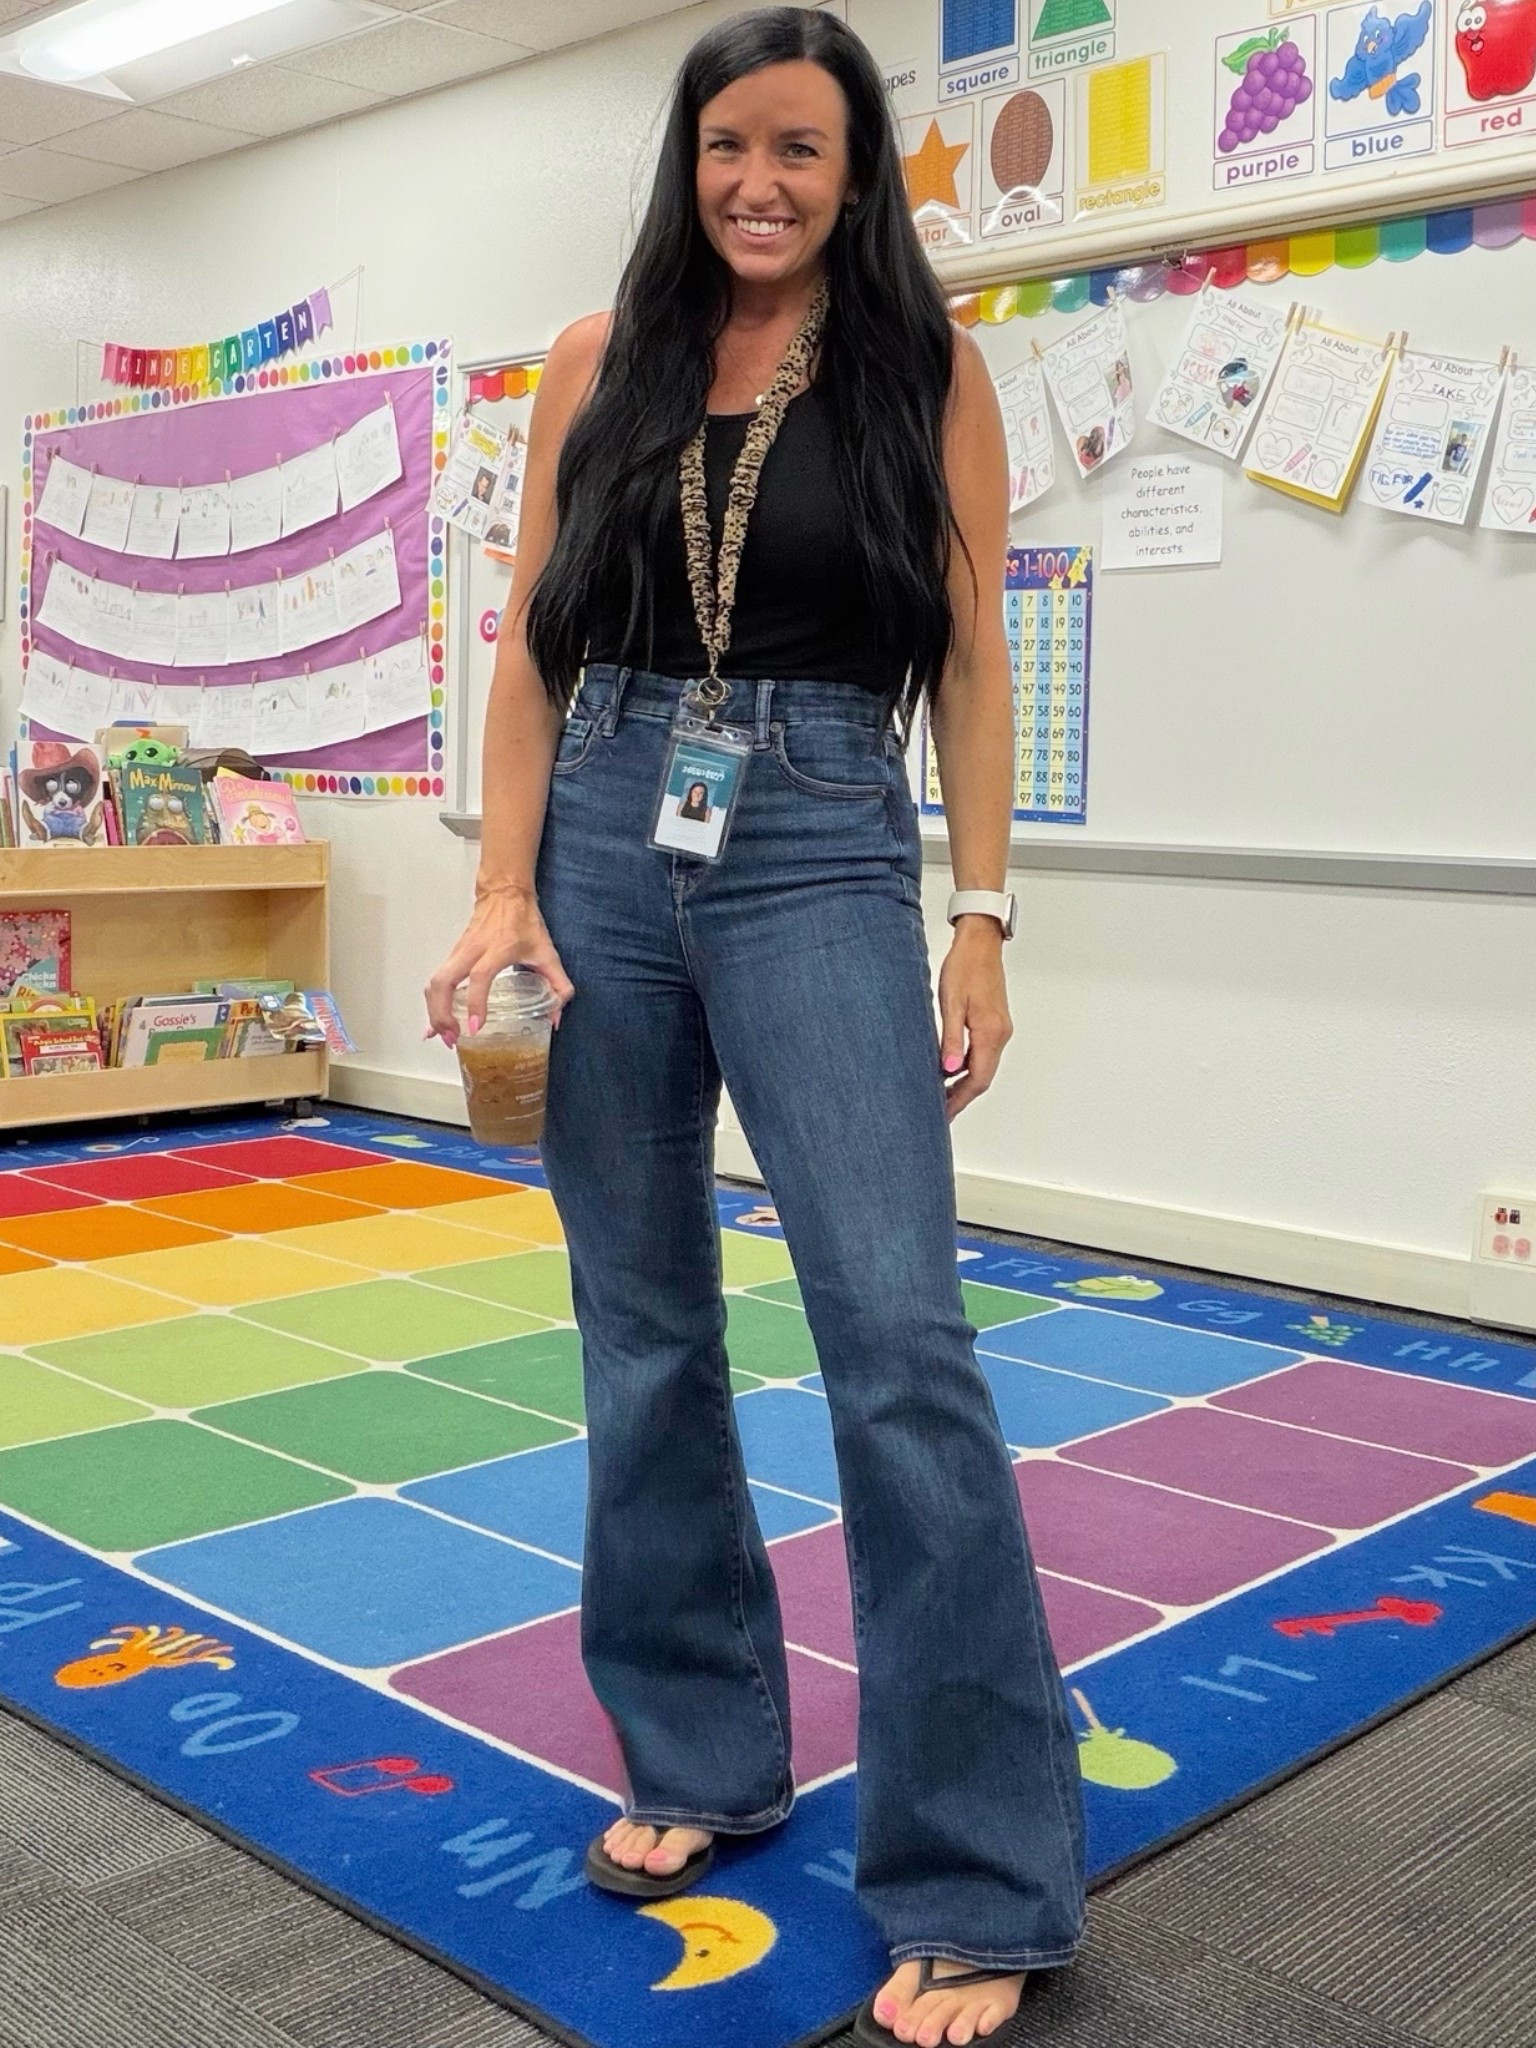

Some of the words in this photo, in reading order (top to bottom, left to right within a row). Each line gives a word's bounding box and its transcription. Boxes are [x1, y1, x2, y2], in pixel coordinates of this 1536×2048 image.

[1035, 40, 1108, 71] triangle
[946, 65, 1010, 95] square
[1480, 108, 1522, 133] red
[1351, 132, 1404, 157] blue
[1226, 153, 1300, 185] purple
[1079, 181, 1161, 211] rectangle
[1001, 204, 1040, 227] oval
[1444, 364, 1473, 376] About
[1131, 465, 1164, 480] People
[1166, 464, 1191, 476] have
[1135, 484, 1185, 498] different
[1128, 525, 1173, 538] abilities,
[1175, 522, 1194, 534] and
[1023, 552, 1069, 578] 1-100
[1011, 596, 1018, 607] 6
[1027, 596, 1034, 606] 7
[1042, 595, 1049, 606] 8
[1058, 594, 1064, 606] 9
[1072, 594, 1082, 606] 10
[1009, 617, 1018, 629] 16
[1024, 617, 1034, 629] 17
[1041, 616, 1049, 628] 18
[1056, 616, 1064, 628] 19
[1070, 616, 1083, 628] 20
[1008, 639, 1020, 651] 26
[1024, 639, 1034, 650] 27
[1039, 639, 1050, 650] 28
[1054, 639, 1066, 651] 29
[1070, 639, 1082, 650] 30
[1023, 661, 1034, 672] 37
[1038, 661, 1050, 673] 38
[1054, 661, 1066, 673] 39
[1070, 661, 1082, 673] 40
[1022, 683, 1034, 694] 47
[1038, 684, 1050, 695] 48
[1054, 684, 1066, 696] 49
[1069, 684, 1082, 696] 50
[1022, 705, 1034, 717] 57
[1038, 706, 1049, 717] 58
[1053, 706, 1064, 718] 59
[1068, 706, 1081, 718] 60
[1022, 727, 1033, 738] 67
[1036, 728, 1049, 738] 68
[1052, 728, 1064, 739] 69
[1068, 728, 1080, 740] 70
[1020, 748, 1033, 760] 77
[1036, 749, 1048, 761] 78
[1052, 750, 1064, 761] 79
[1068, 750, 1079, 762] 80
[129, 768, 158, 790] Max
[1020, 770, 1032, 782] 87
[1036, 772, 1048, 783] 88
[1052, 772, 1064, 784] 89
[1066, 772, 1080, 784] 90
[930, 787, 938, 798] 91
[1020, 792, 1032, 804] 97
[1036, 793, 1047, 804] 98
[1050, 794, 1064, 806] 99
[1064, 794, 1080, 806] 100
[153, 1013, 196, 1027] Gossie's
[986, 1256, 1063, 1281] Ff
[1176, 1299, 1266, 1326] Gg
[1393, 1340, 1501, 1373] Hh
[1389, 1545, 1536, 1589] Kk
